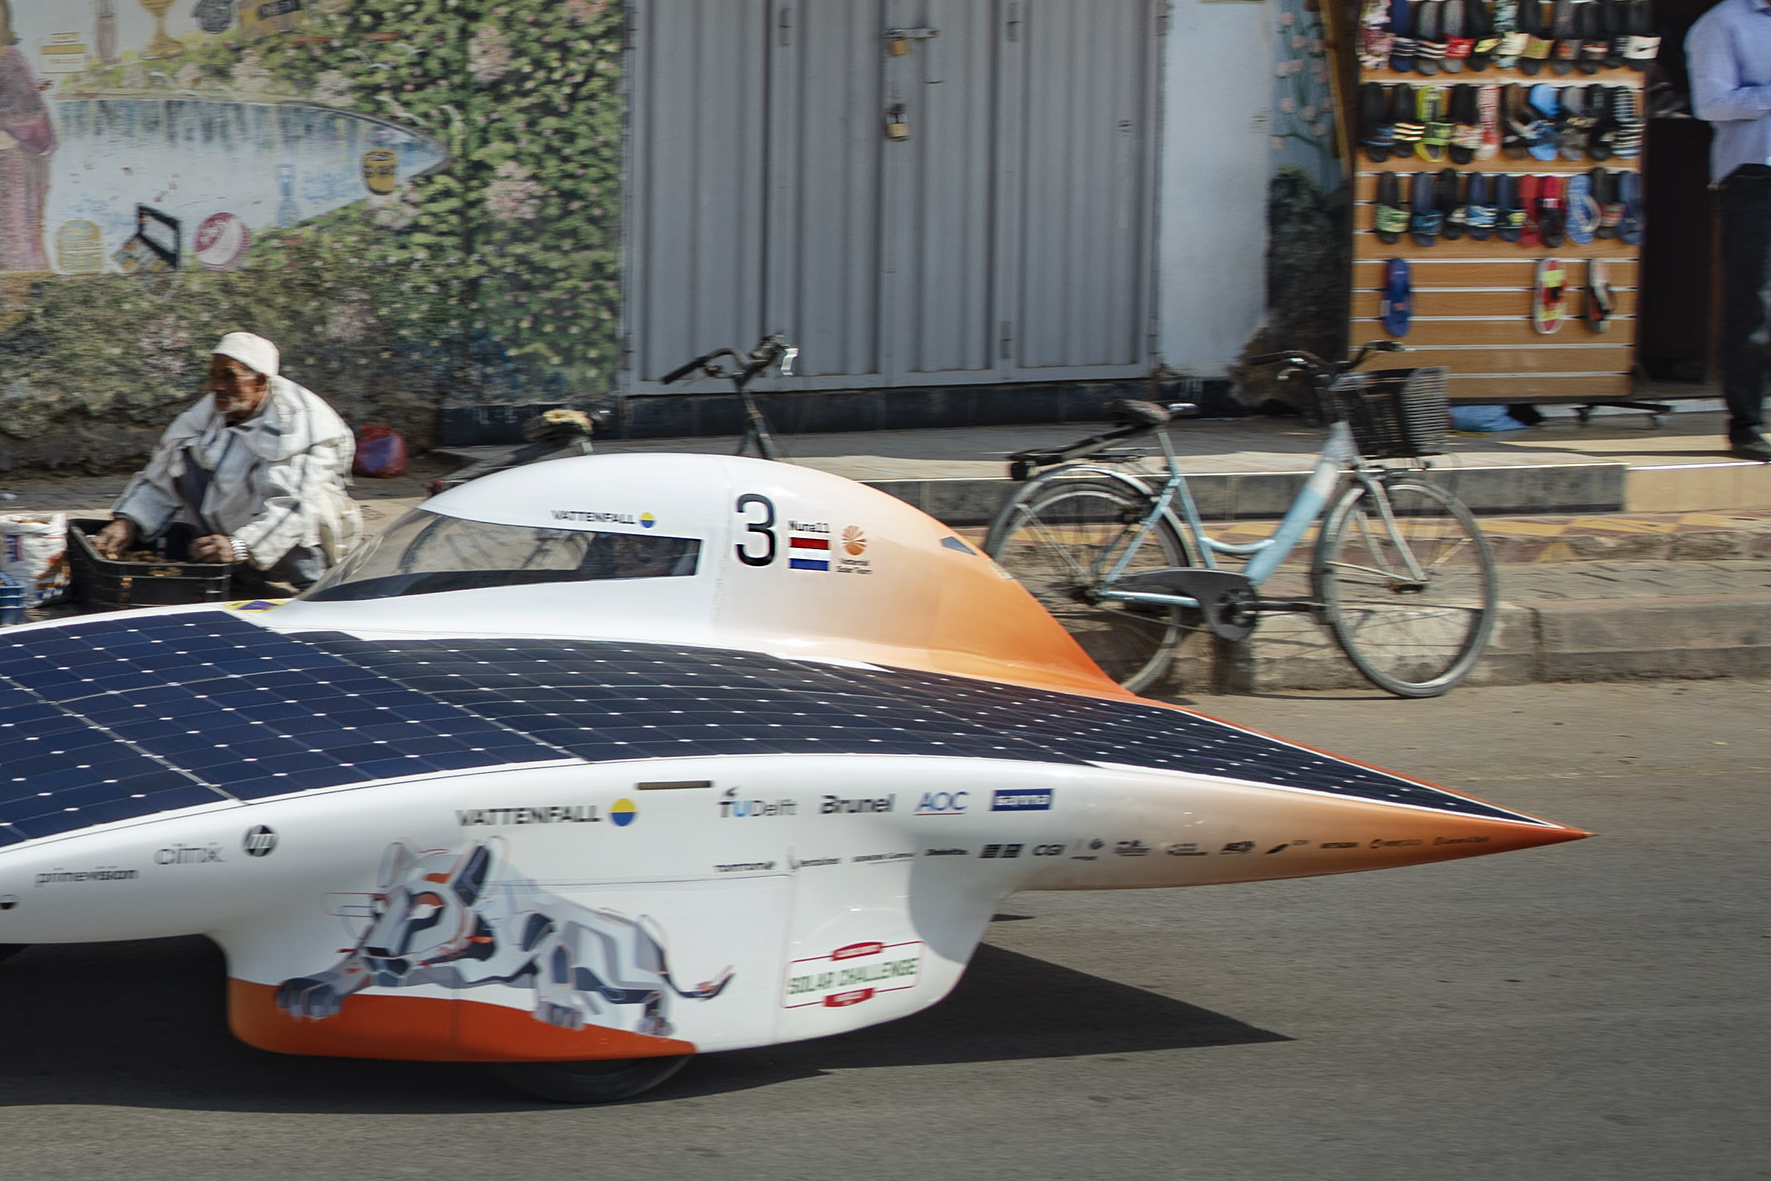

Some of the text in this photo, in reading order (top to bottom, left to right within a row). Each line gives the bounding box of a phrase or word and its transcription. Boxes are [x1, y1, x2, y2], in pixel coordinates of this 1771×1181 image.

[551, 509, 637, 525] VATTENFALL
[734, 492, 776, 567] 3
[820, 793, 896, 815] Brunel
[913, 791, 969, 812] AOC
[456, 804, 603, 827] VATTENFALL
